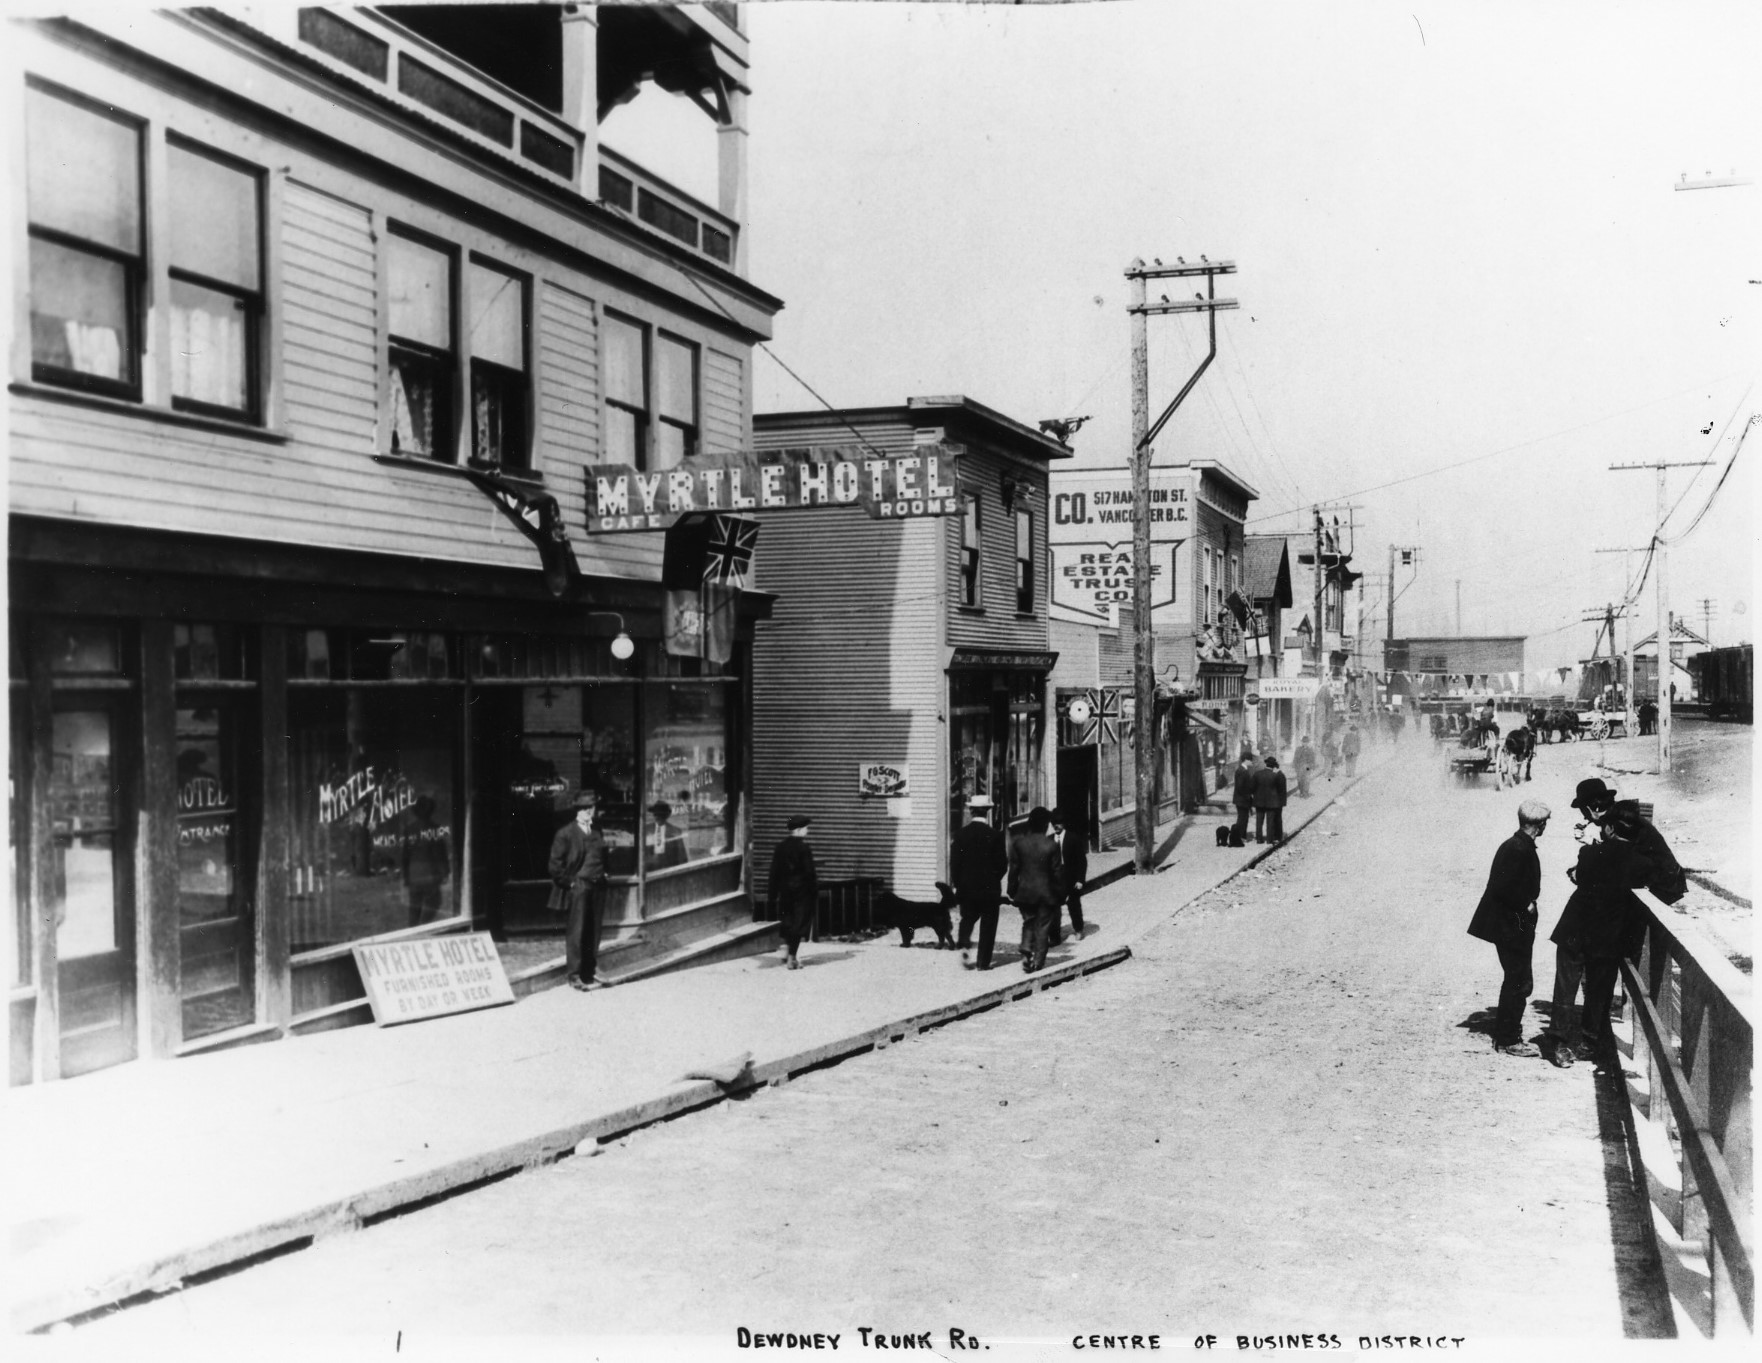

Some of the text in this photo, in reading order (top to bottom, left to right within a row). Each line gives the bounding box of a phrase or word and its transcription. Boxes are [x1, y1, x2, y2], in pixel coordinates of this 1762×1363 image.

[597, 456, 954, 516] MYRTLE HOTEL
[1093, 488, 1188, 505] 517 HAMTON ST.
[880, 498, 956, 516] ROOMS
[1055, 492, 1094, 525] CO.
[1098, 507, 1188, 523] VANCOER B.C.
[600, 514, 661, 530] CAFE
[1080, 553, 1132, 564] REA
[1063, 565, 1162, 577] ESTAE
[1070, 577, 1156, 589] TRUS
[1263, 685, 1312, 693] BAKERY
[319, 766, 418, 823] MYRTLE HOTEL
[360, 936, 496, 977] MYRTLE HOTEL
[383, 967, 493, 995] FURNISHED ROOMS
[398, 984, 493, 1013] BY DAY OR WEEK
